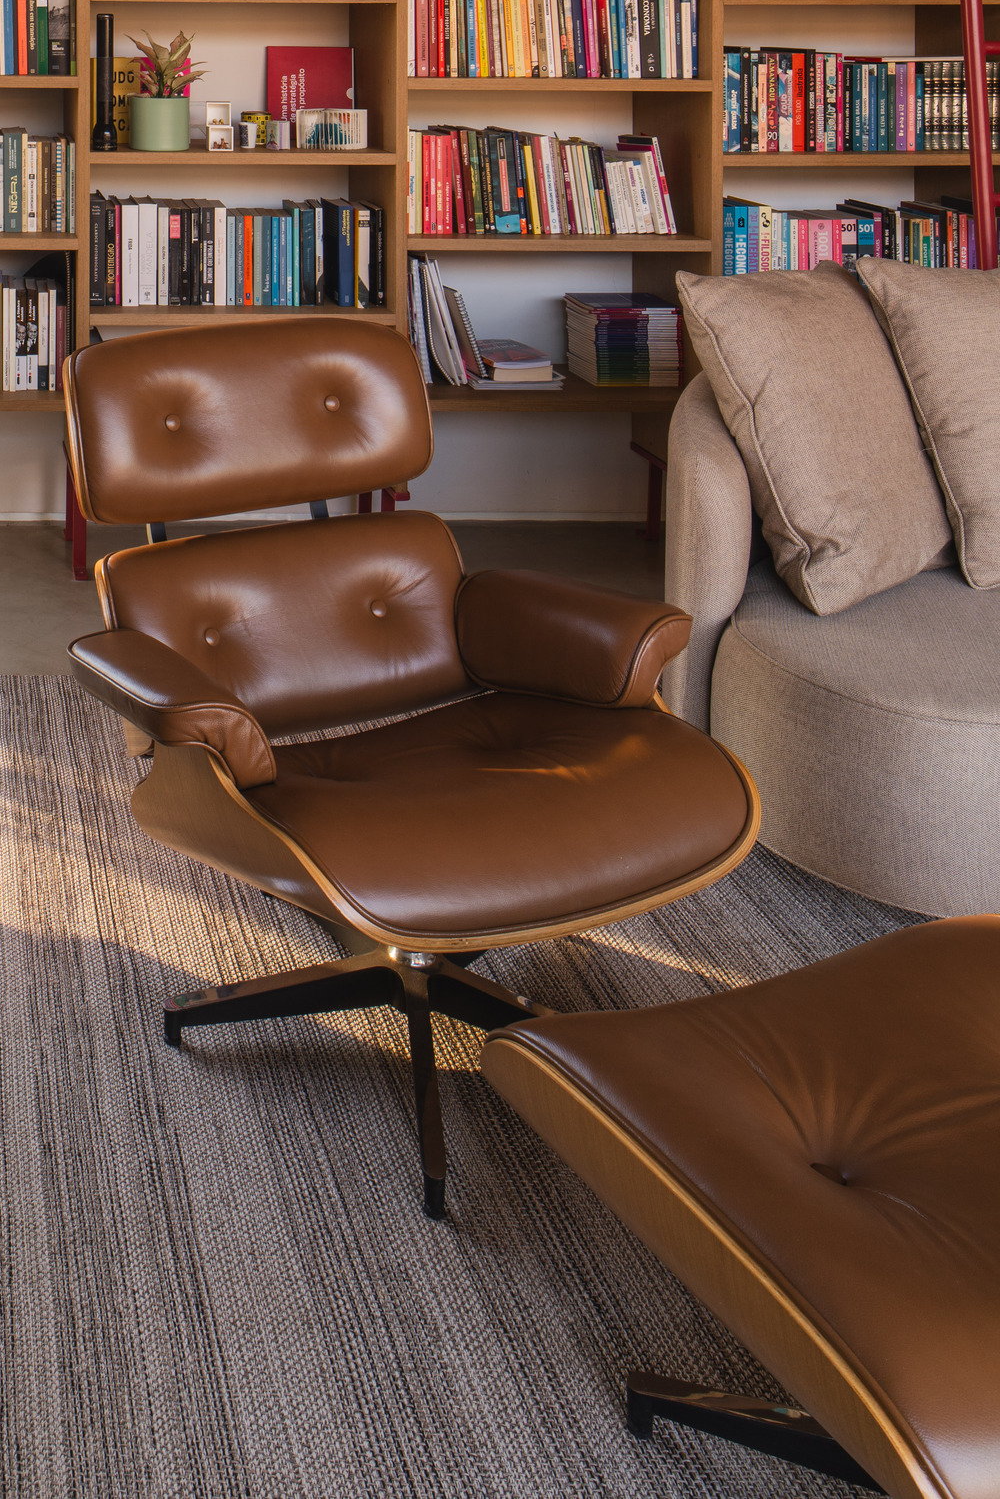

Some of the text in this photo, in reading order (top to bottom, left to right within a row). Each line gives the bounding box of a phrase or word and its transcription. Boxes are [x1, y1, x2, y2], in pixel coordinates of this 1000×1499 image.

[28, 22, 36, 50] transição
[289, 74, 298, 123] de estratégia
[298, 68, 306, 105] propósito
[768, 132, 777, 140] 90
[8, 175, 17, 214] NEGRA
[632, 189, 641, 213] VISUAIS
[654, 192, 664, 219] Generation
[841, 223, 857, 233] 501
[859, 224, 874, 233] 501
[145, 232, 153, 275] MANDELA
[818, 231, 828, 257] 1001
[107, 243, 115, 284] MONTENEGRO
